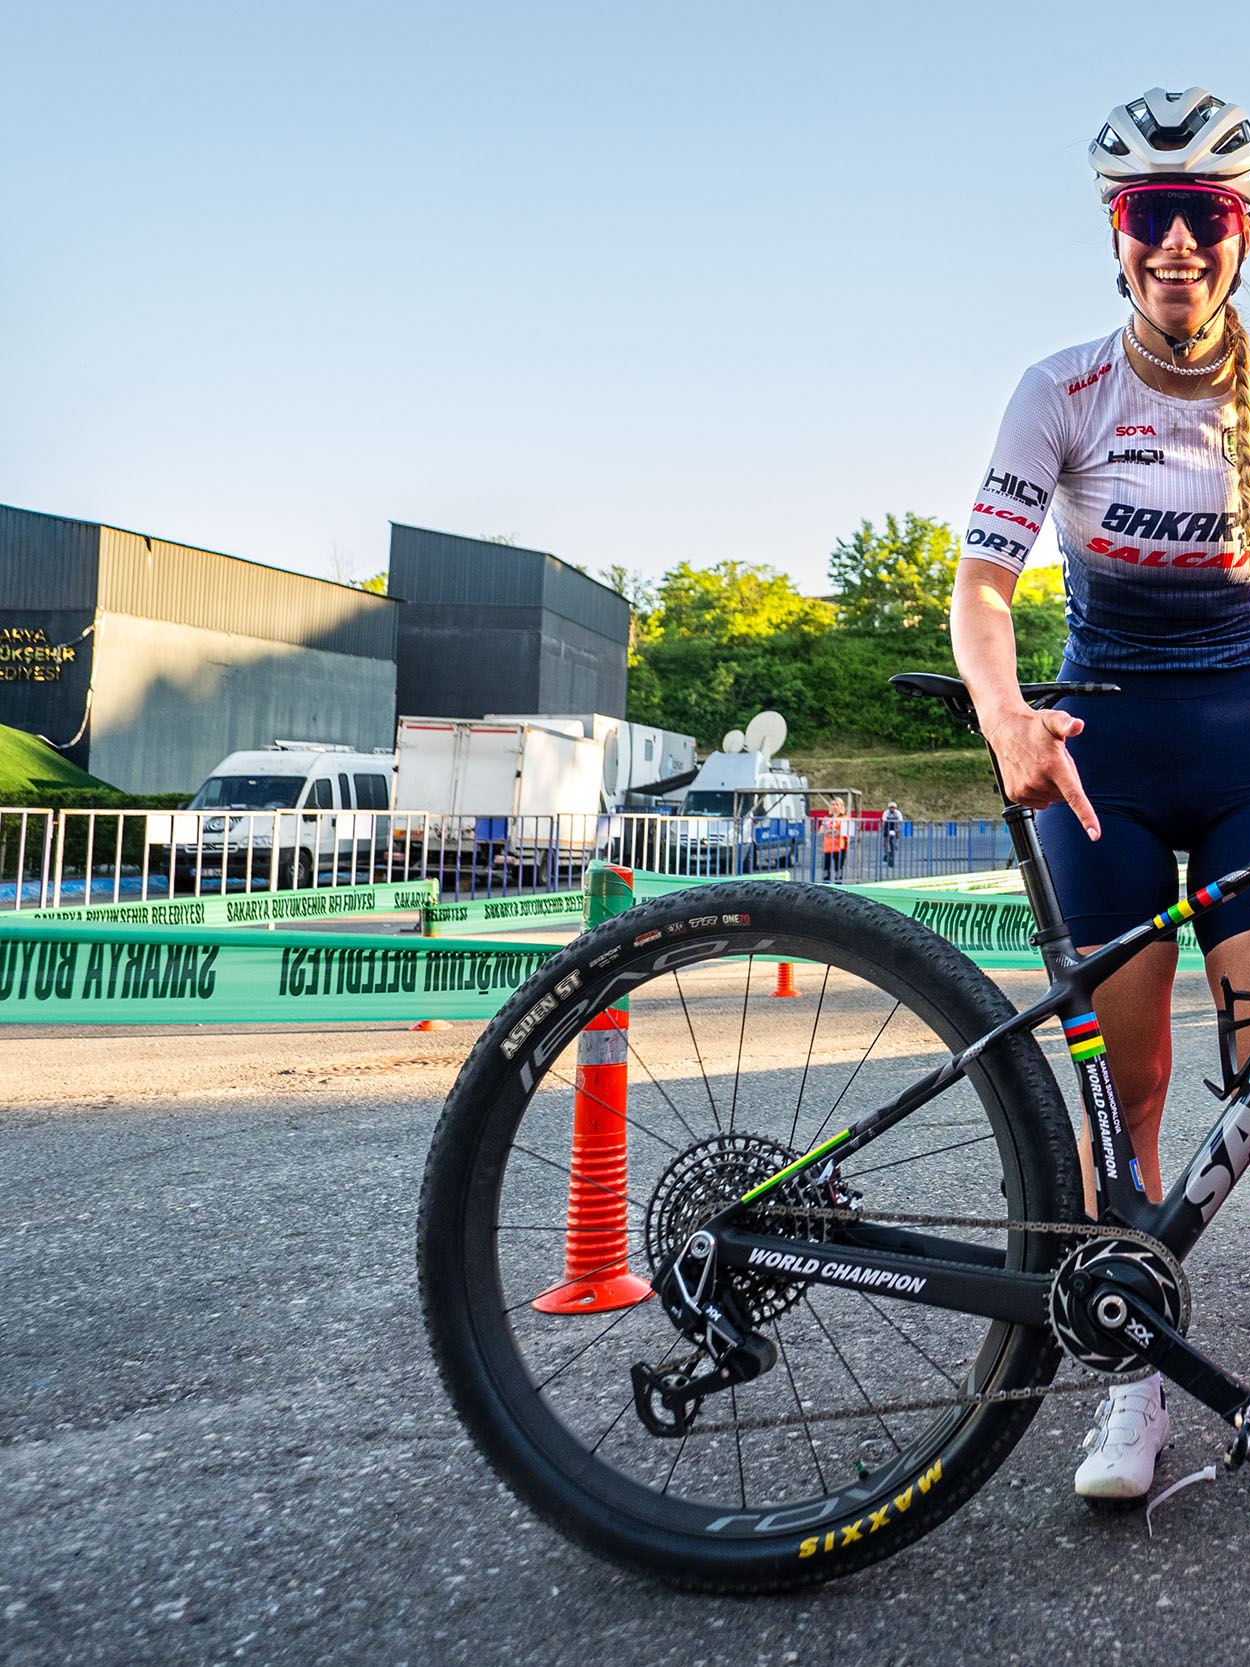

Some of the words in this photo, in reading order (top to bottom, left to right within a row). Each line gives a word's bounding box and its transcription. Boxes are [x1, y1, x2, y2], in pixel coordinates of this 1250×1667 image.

[1068, 363, 1112, 395] SALCANO
[1115, 425, 1157, 437] SORA
[984, 468, 1048, 512] HIQ!
[973, 502, 1041, 536] ALCAN
[226, 900, 270, 922] SAKARYA
[500, 992, 559, 1060] ASPEN
[554, 968, 583, 1000] ST
[1086, 1063, 1105, 1108] WORLD
[1097, 1109, 1119, 1179] CHAMPION
[748, 1248, 820, 1274] WORLD
[821, 1262, 928, 1294] CHAMPION
[798, 1458, 943, 1560] MAXXIS
